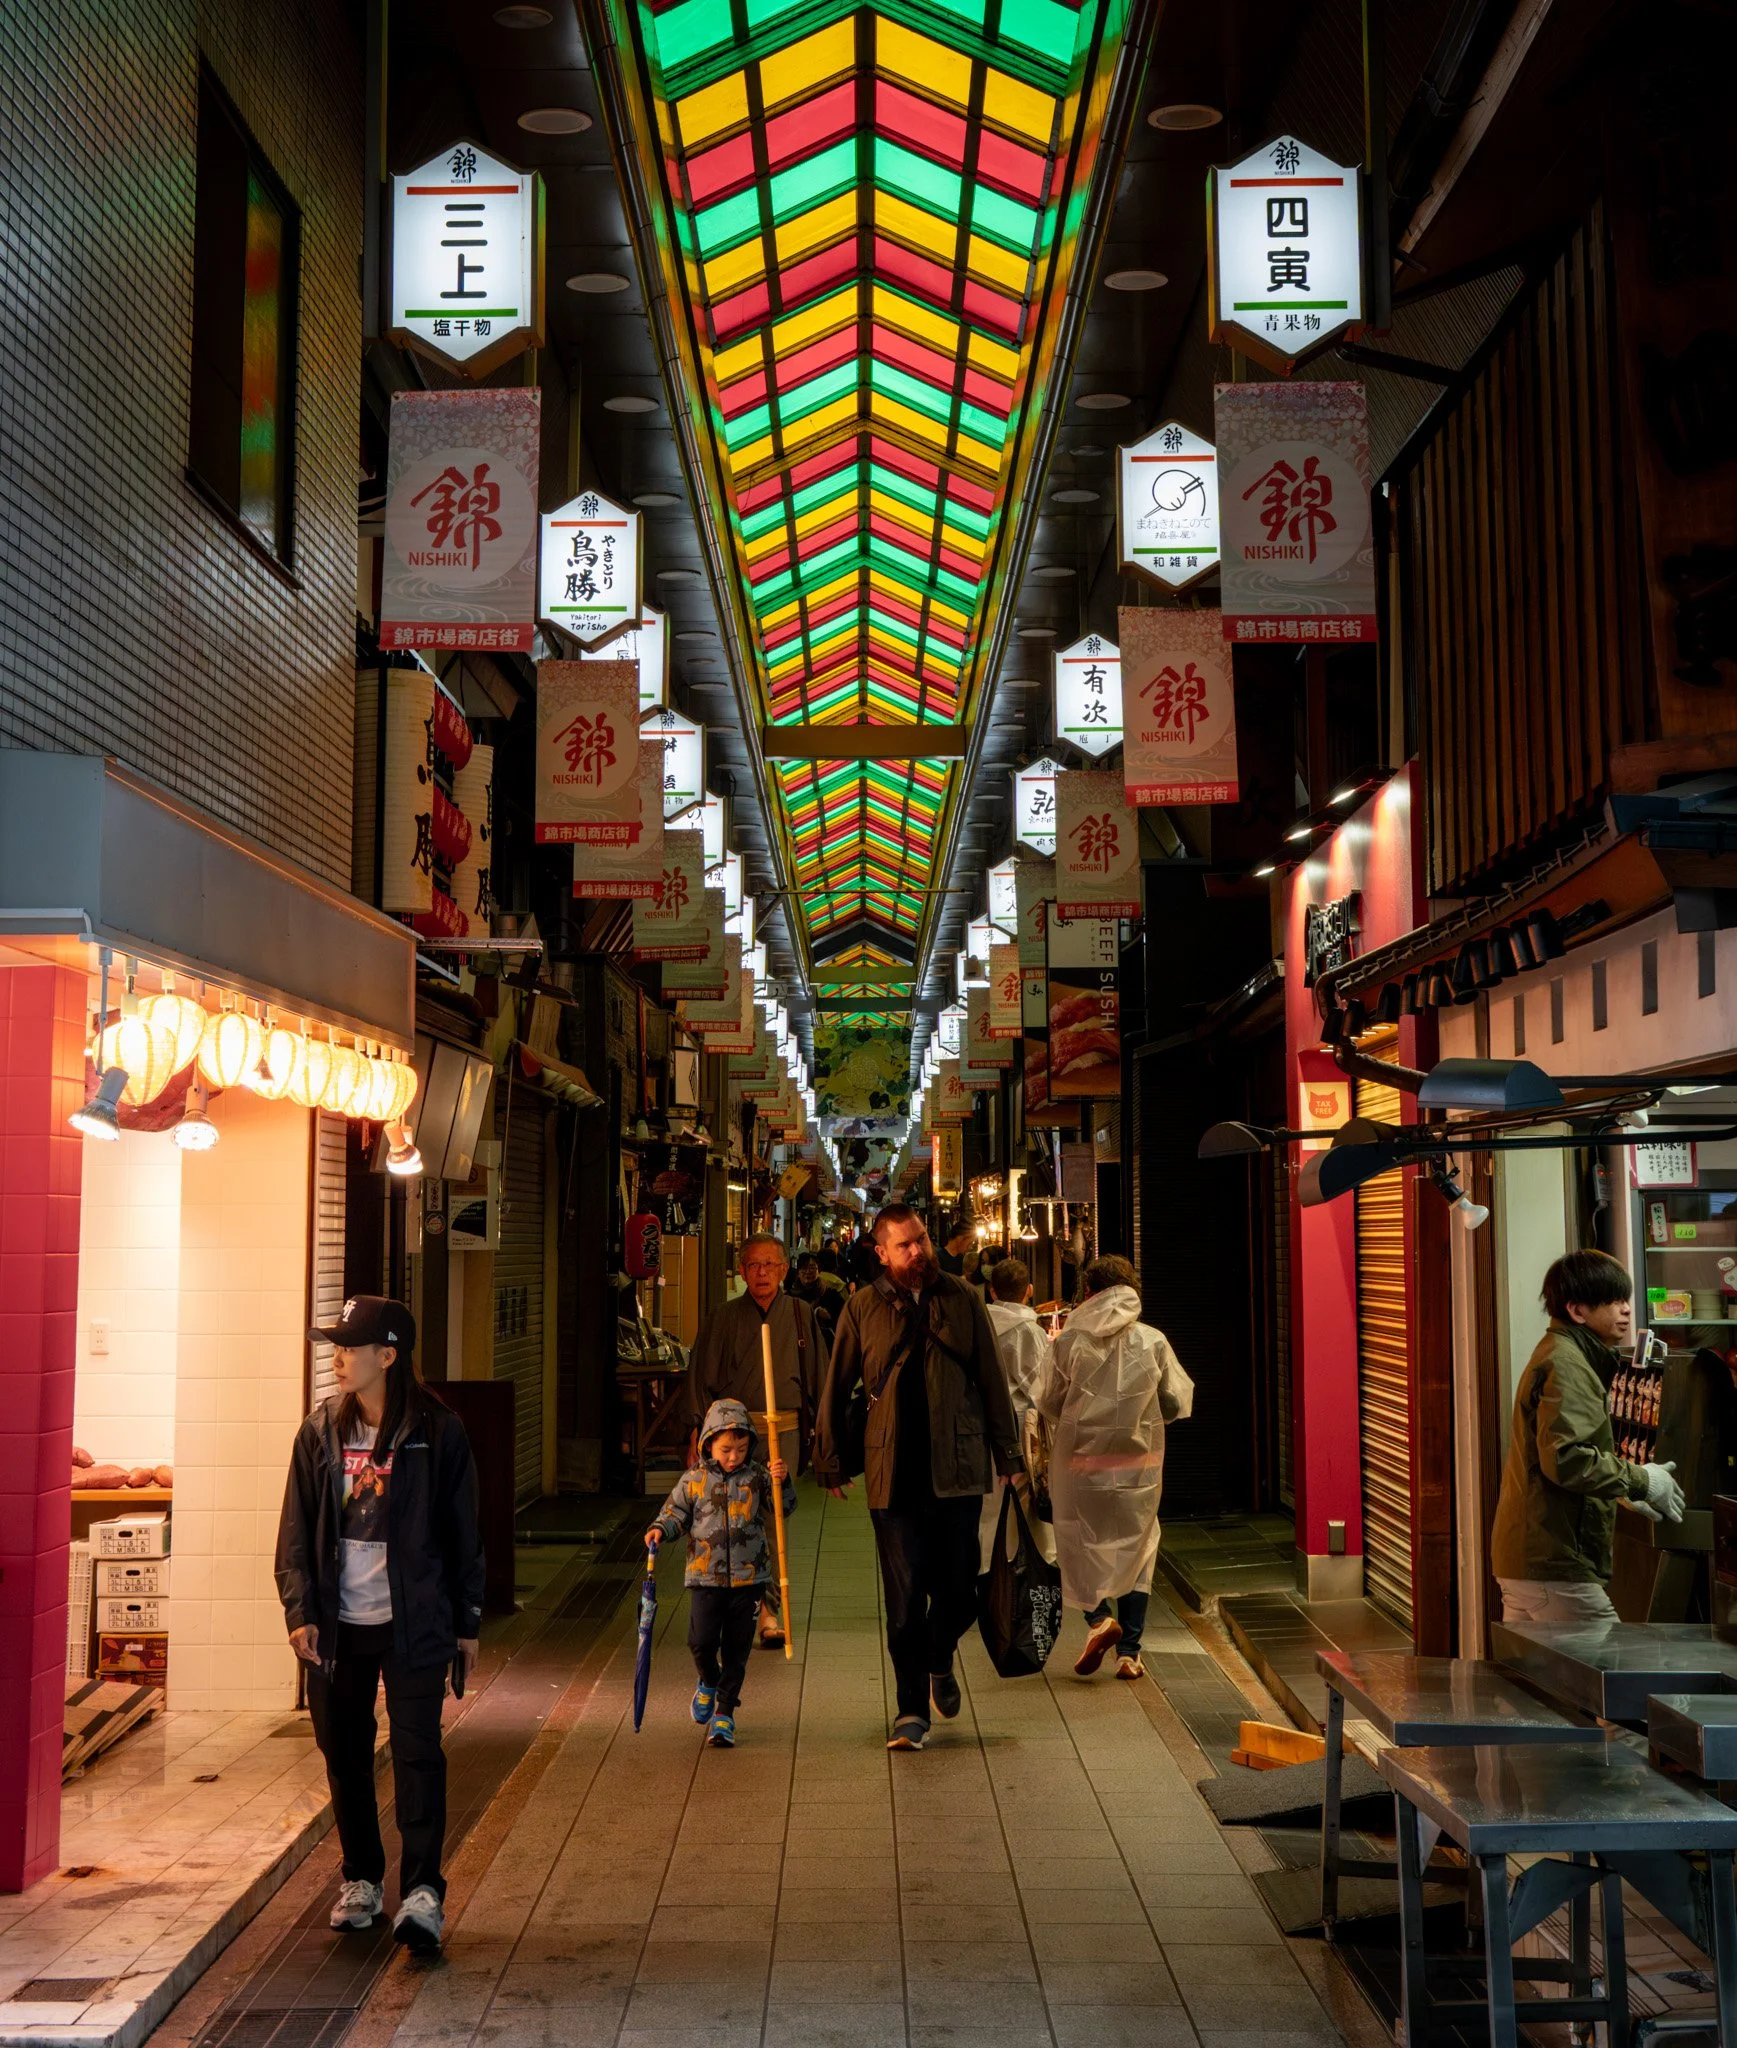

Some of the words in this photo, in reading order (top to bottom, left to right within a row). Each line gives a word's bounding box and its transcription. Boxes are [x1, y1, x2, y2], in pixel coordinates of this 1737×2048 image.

[446, 147, 478, 183] 錦
[1269, 140, 1301, 175] 錦
[440, 203, 489, 299] 三上
[1266, 197, 1311, 293] 四寅
[433, 319, 491, 337] 塩干物
[1263, 314, 1321, 331] 青果物
[1159, 426, 1183, 453] 錦
[409, 462, 503, 573] 錦
[1241, 455, 1338, 565] 錦
[1135, 516, 1212, 530] まねきねこのて
[408, 552, 467, 566] NISHIKI
[601, 534, 616, 591] やきとり
[1153, 556, 1198, 568] 和雑貨
[1244, 545, 1304, 560] NISHIKI
[564, 529, 601, 602] 鳥勝
[392, 626, 520, 647] 錦市場商店街
[570, 622, 608, 631] Torisho
[1235, 619, 1362, 639] 錦市場商店街
[1082, 664, 1108, 725] 有次
[1138, 661, 1210, 746] 錦
[1141, 730, 1186, 743] NISHIKI
[552, 711, 617, 788] 錦
[552, 773, 594, 784] NISHIKI
[1135, 785, 1229, 805] 錦市場商店街
[544, 826, 631, 841] 錦市場商店街
[1068, 812, 1121, 875] 錦
[1069, 863, 1102, 873] NISHIKI
[581, 883, 655, 897] 錦市場商店街
[1064, 903, 1133, 918] 錦市場商店街
[1100, 972, 1116, 1032] SUSHI
[1315, 1107, 1333, 1115] FREE
